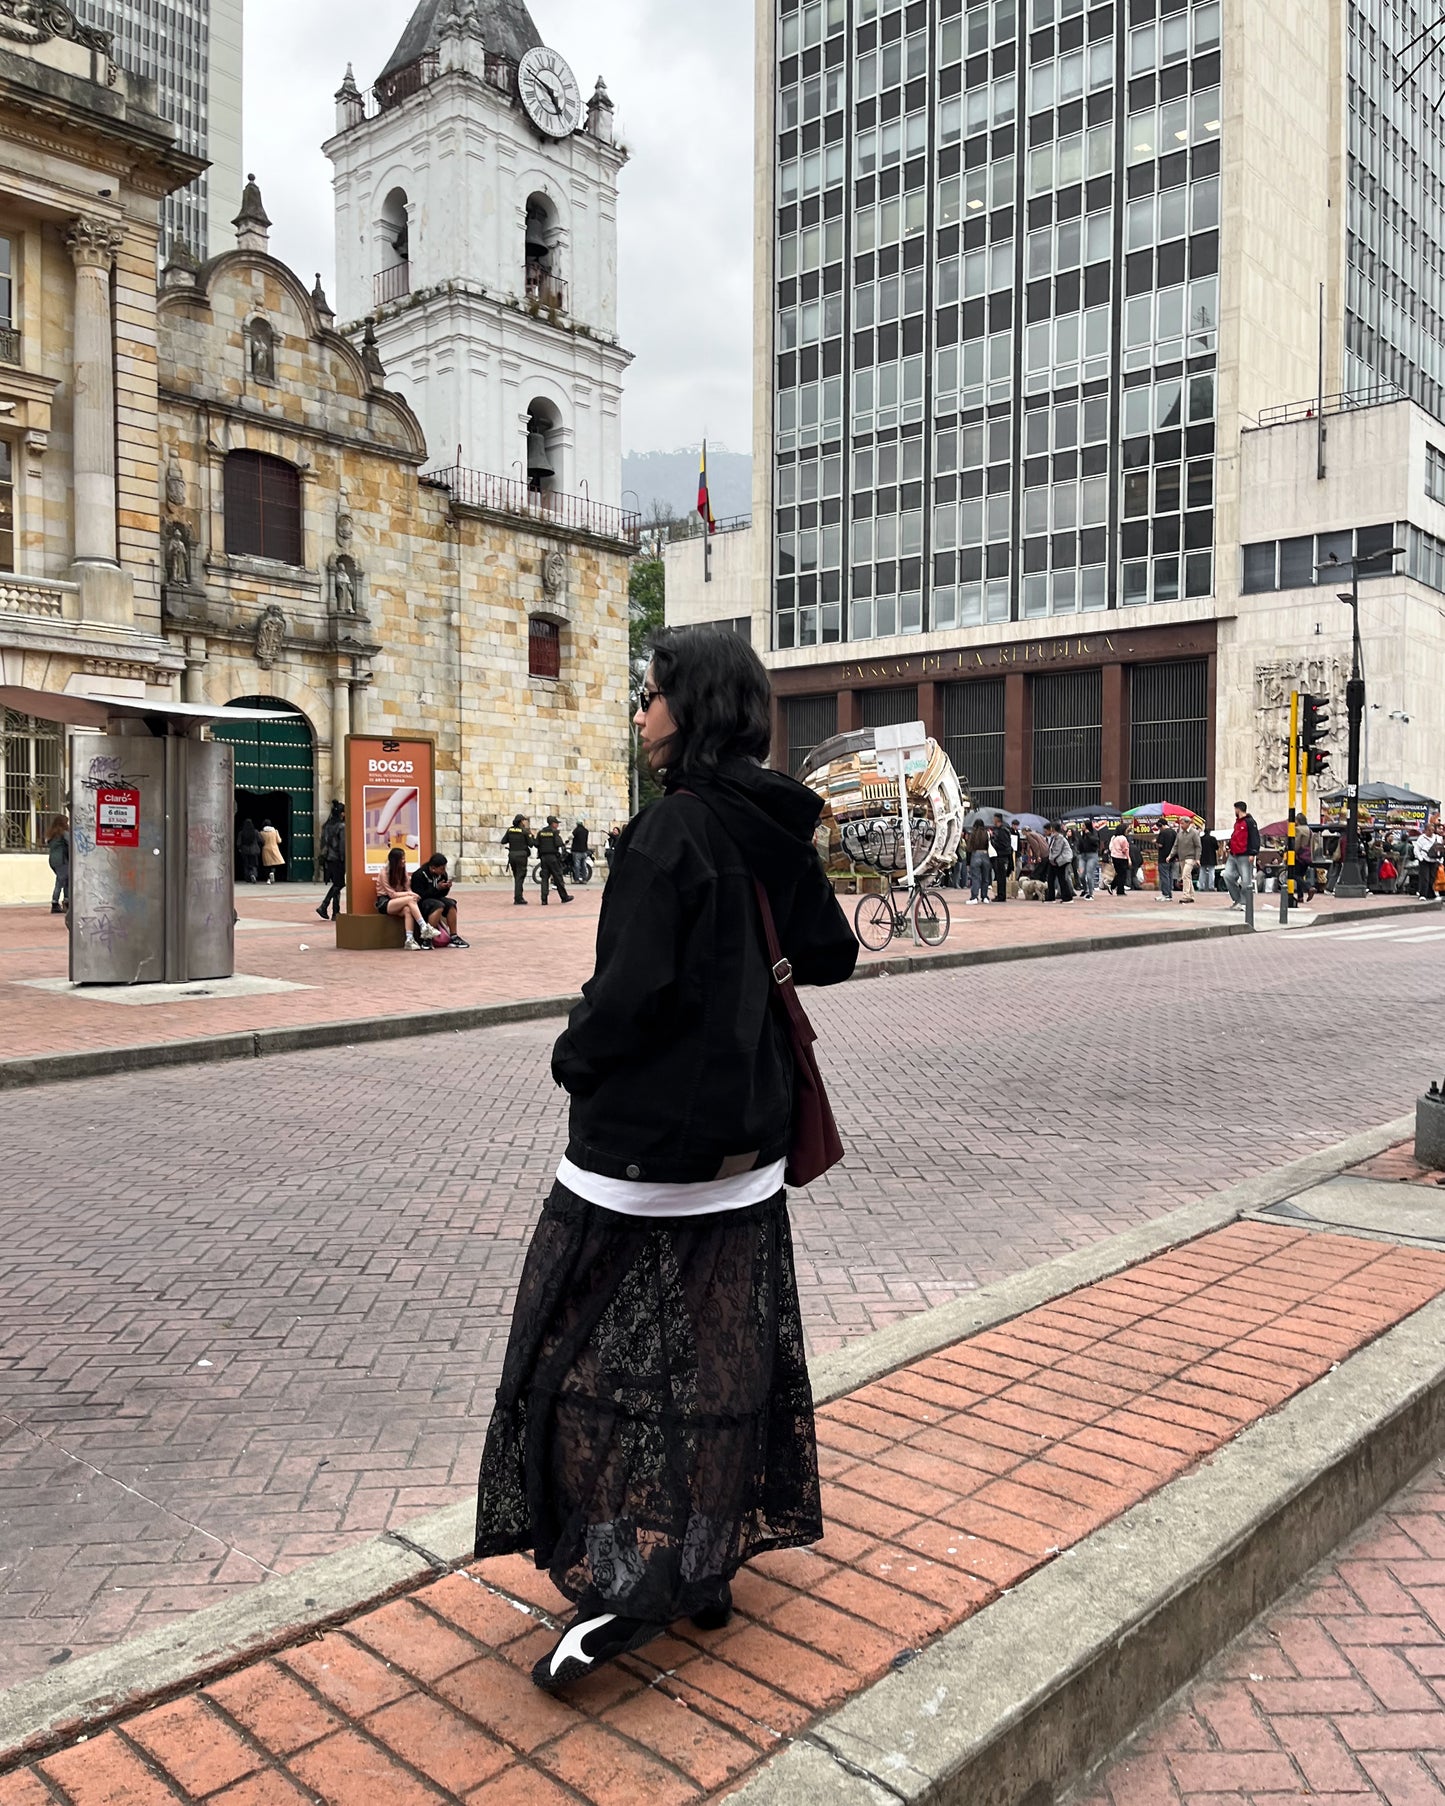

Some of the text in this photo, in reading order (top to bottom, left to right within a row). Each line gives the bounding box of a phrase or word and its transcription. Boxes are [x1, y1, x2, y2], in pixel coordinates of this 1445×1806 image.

[841, 660, 910, 680] BANCO
[921, 654, 942, 672] DE
[956, 651, 984, 668] LA
[368, 759, 414, 773] BOG25
[104, 793, 128, 803] Claro
